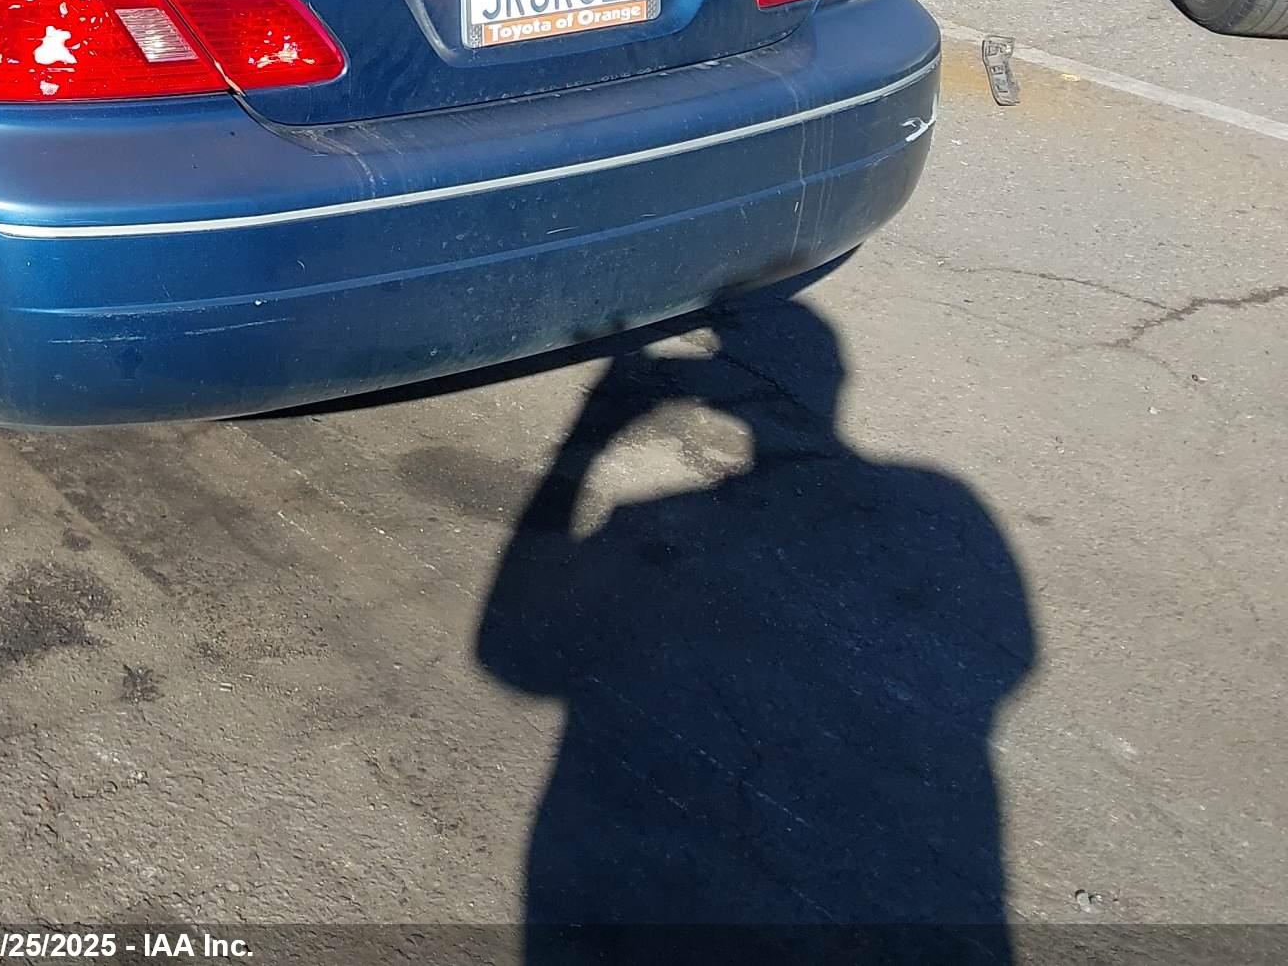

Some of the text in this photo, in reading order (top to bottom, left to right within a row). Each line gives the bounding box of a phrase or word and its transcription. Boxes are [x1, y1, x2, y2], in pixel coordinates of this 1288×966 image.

[488, 5, 642, 42] Toyota of Orange
